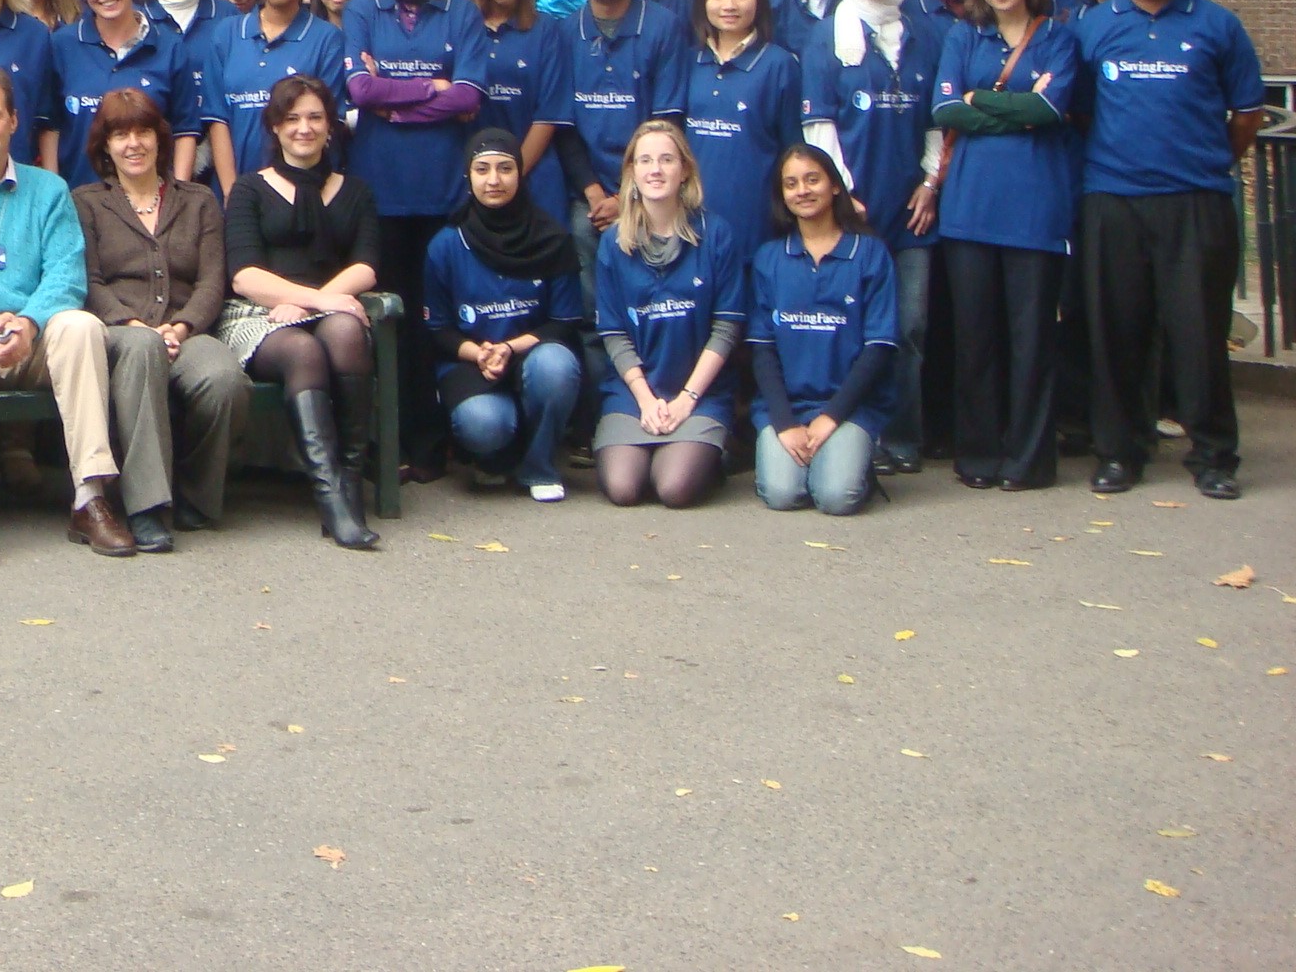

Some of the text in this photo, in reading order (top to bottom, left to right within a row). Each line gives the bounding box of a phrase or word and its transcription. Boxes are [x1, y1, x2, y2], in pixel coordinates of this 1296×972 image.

[380, 60, 443, 71] SavingFaces
[1119, 60, 1189, 73] SavingFaces
[574, 92, 636, 104] SavingFaces
[686, 118, 742, 132] SavingFaces
[475, 299, 540, 315] SavingFaces
[636, 299, 696, 316] SavingFaces
[780, 312, 847, 325] SavingFaces
